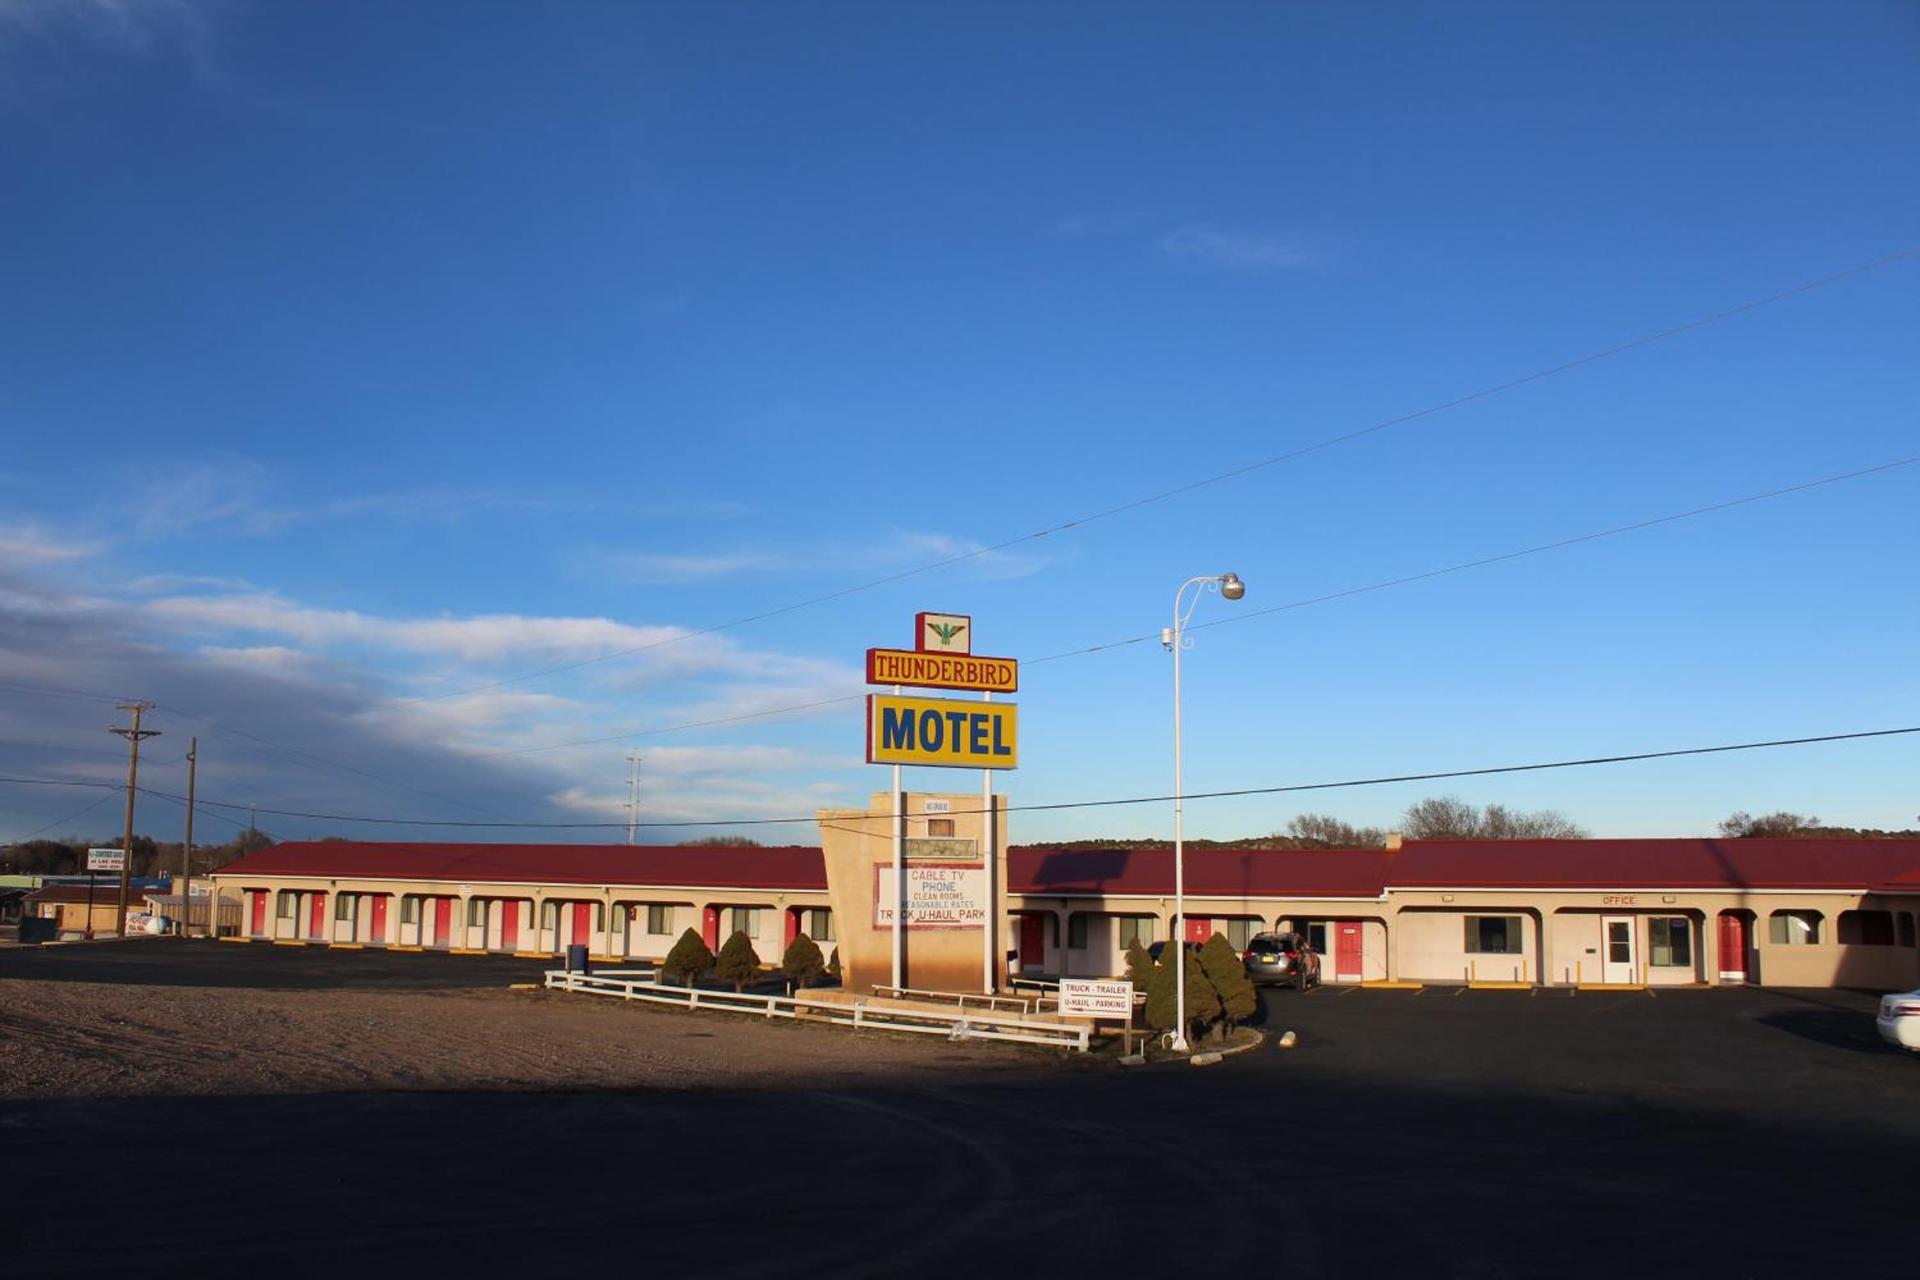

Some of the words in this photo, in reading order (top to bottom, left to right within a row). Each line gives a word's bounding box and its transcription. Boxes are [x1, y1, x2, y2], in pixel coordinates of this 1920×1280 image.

[877, 655, 1012, 686] THUNDERBIRD
[882, 706, 1012, 756] MOTEL
[911, 870, 946, 881] CABLE
[951, 871, 965, 881] TV
[922, 881, 957, 892] PHONE
[913, 892, 938, 901] CLEAN
[939, 892, 964, 901] ROOMS
[1603, 895, 1635, 905] OFFICE
[902, 900, 948, 909] REASONABLE
[951, 900, 975, 909] RATES
[879, 909, 914, 920] TRCK
[959, 909, 986, 920] PARK
[1065, 983, 1090, 993] TRUCK
[1096, 984, 1127, 994] TRAILER
[1064, 998, 1090, 1007] U-HAUL
[1095, 999, 1126, 1008] PARKING
